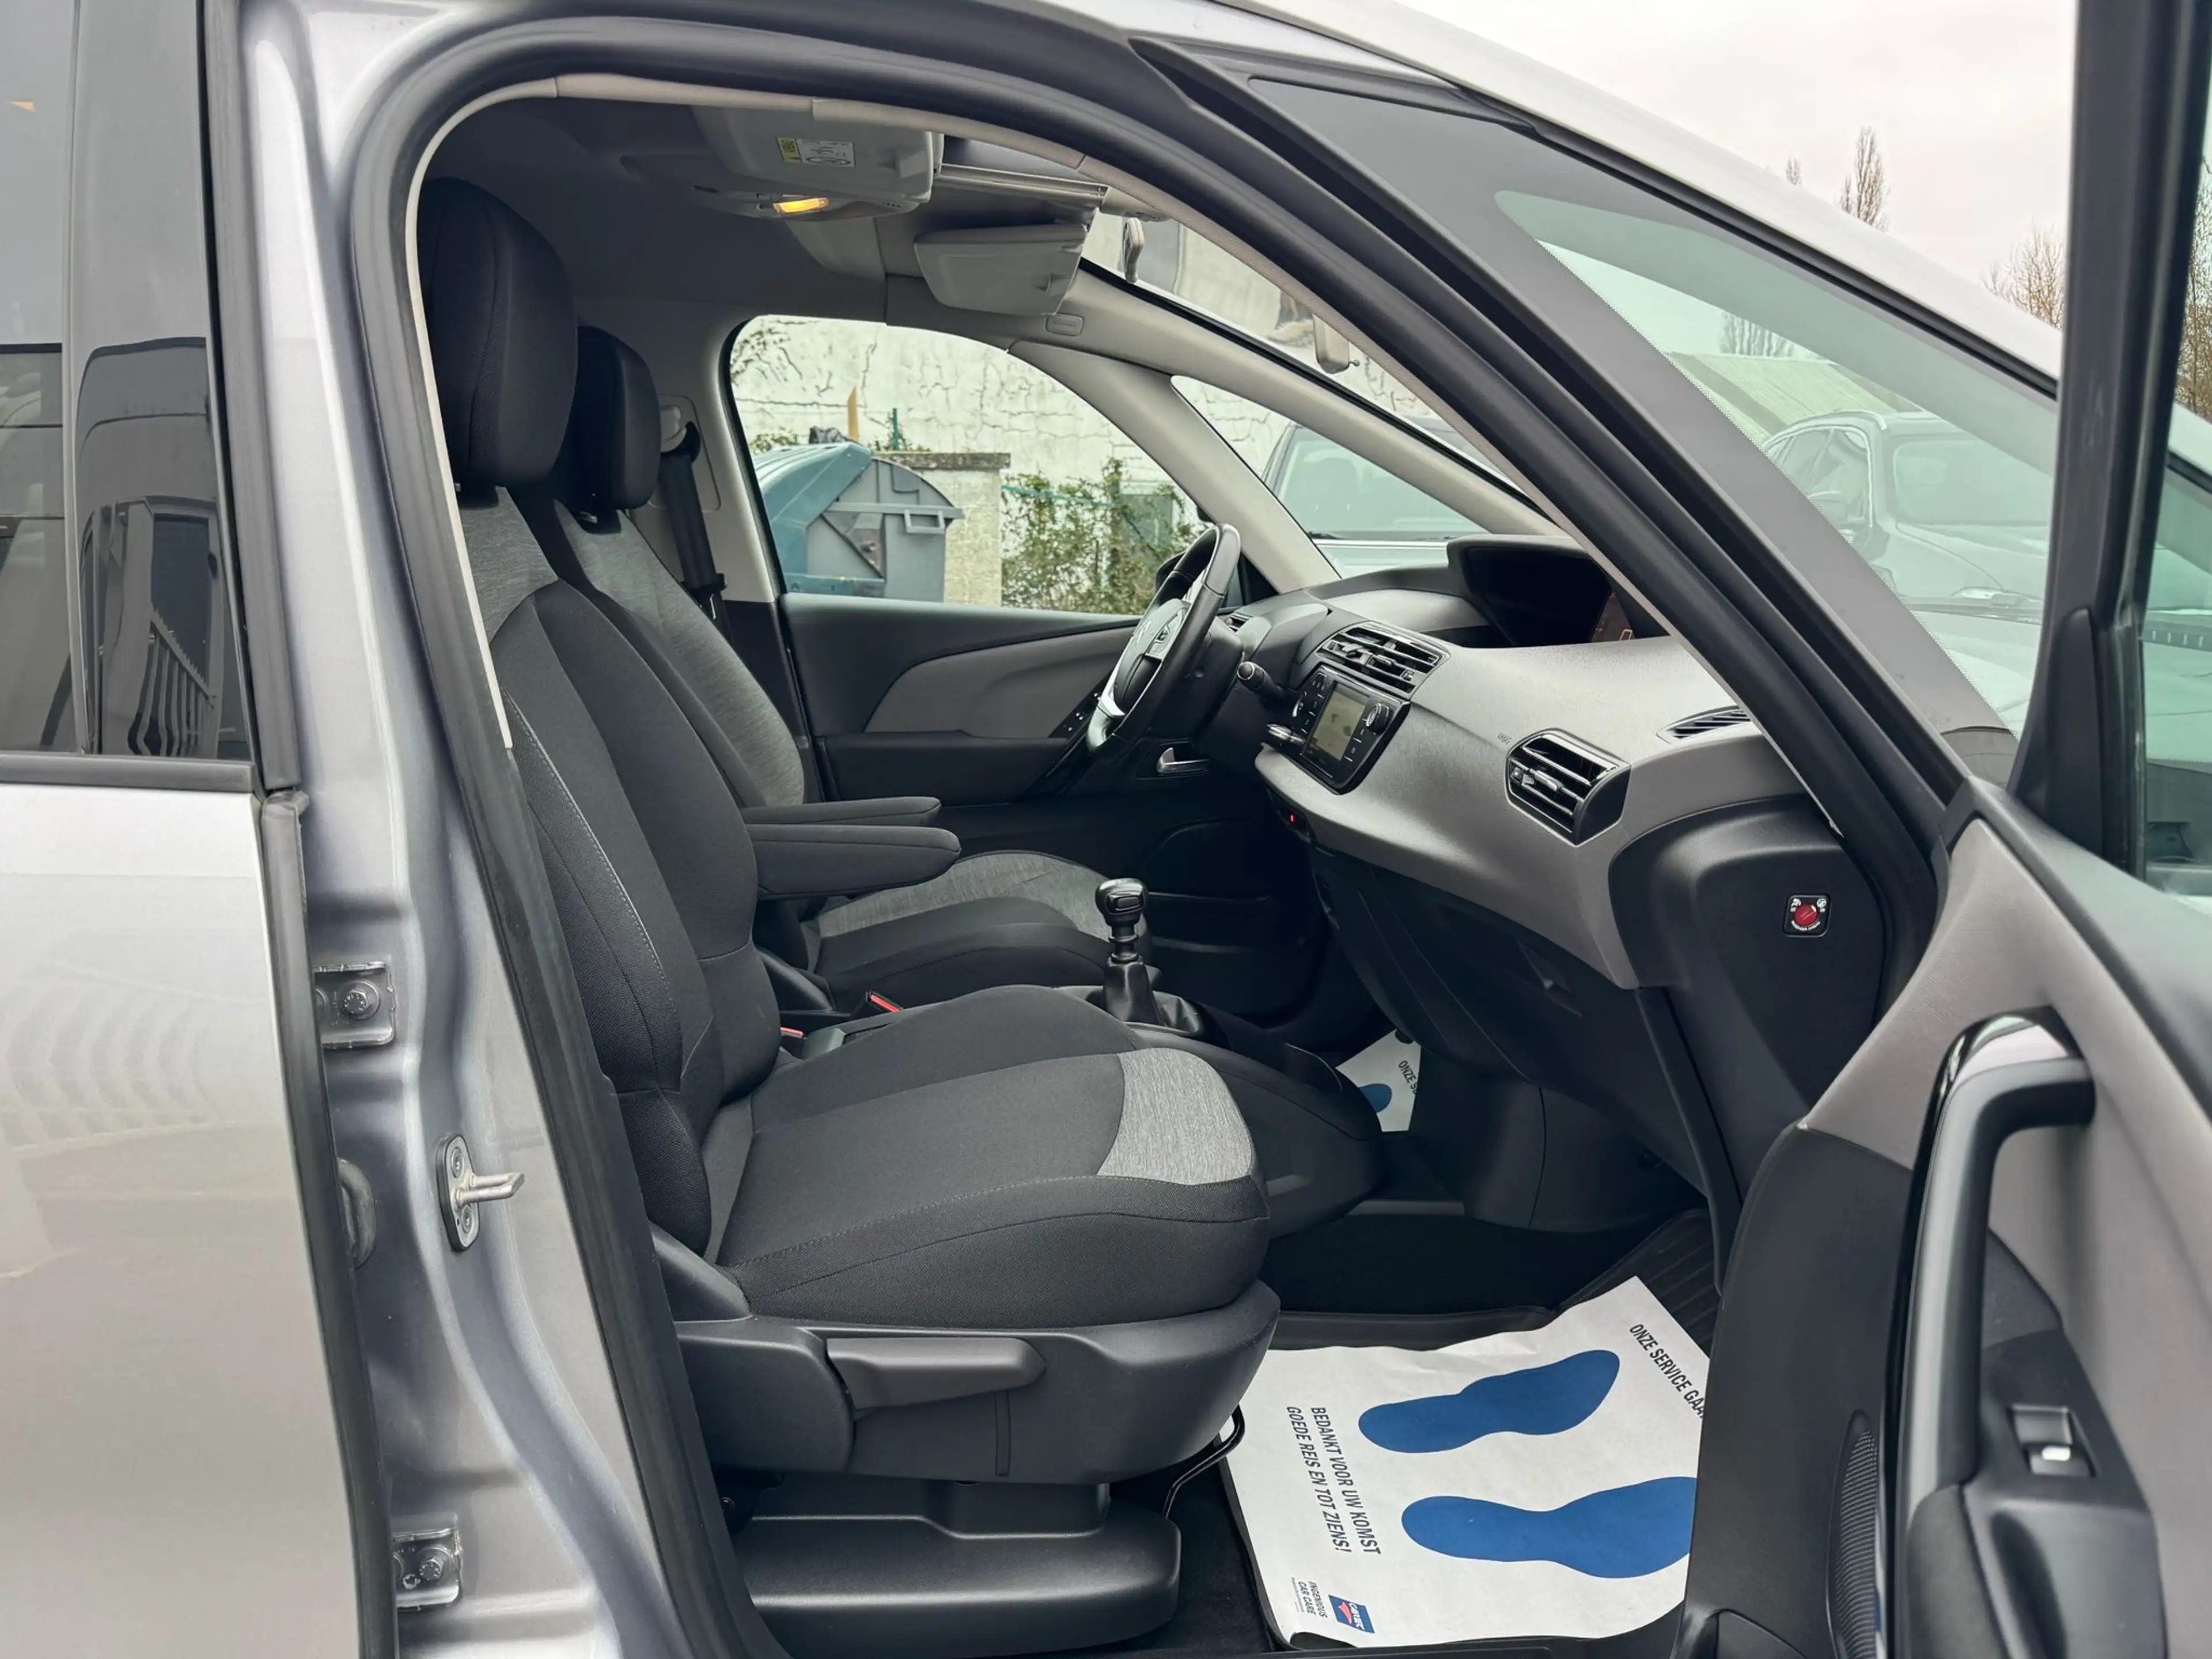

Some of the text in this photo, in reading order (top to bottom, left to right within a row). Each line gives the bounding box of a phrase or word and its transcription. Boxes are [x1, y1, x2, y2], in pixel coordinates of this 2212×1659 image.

[1399, 1060, 1416, 1083] ONZE
[1630, 1324, 1705, 1418] ONZE SERVICE GAA
[1286, 1406, 1352, 1552] GOEDE REIS EN TOT ZIENS!
[1310, 1407, 1381, 1554] BEDANKT VOOR UW KOMST
[1298, 1581, 1309, 1596] CAR
